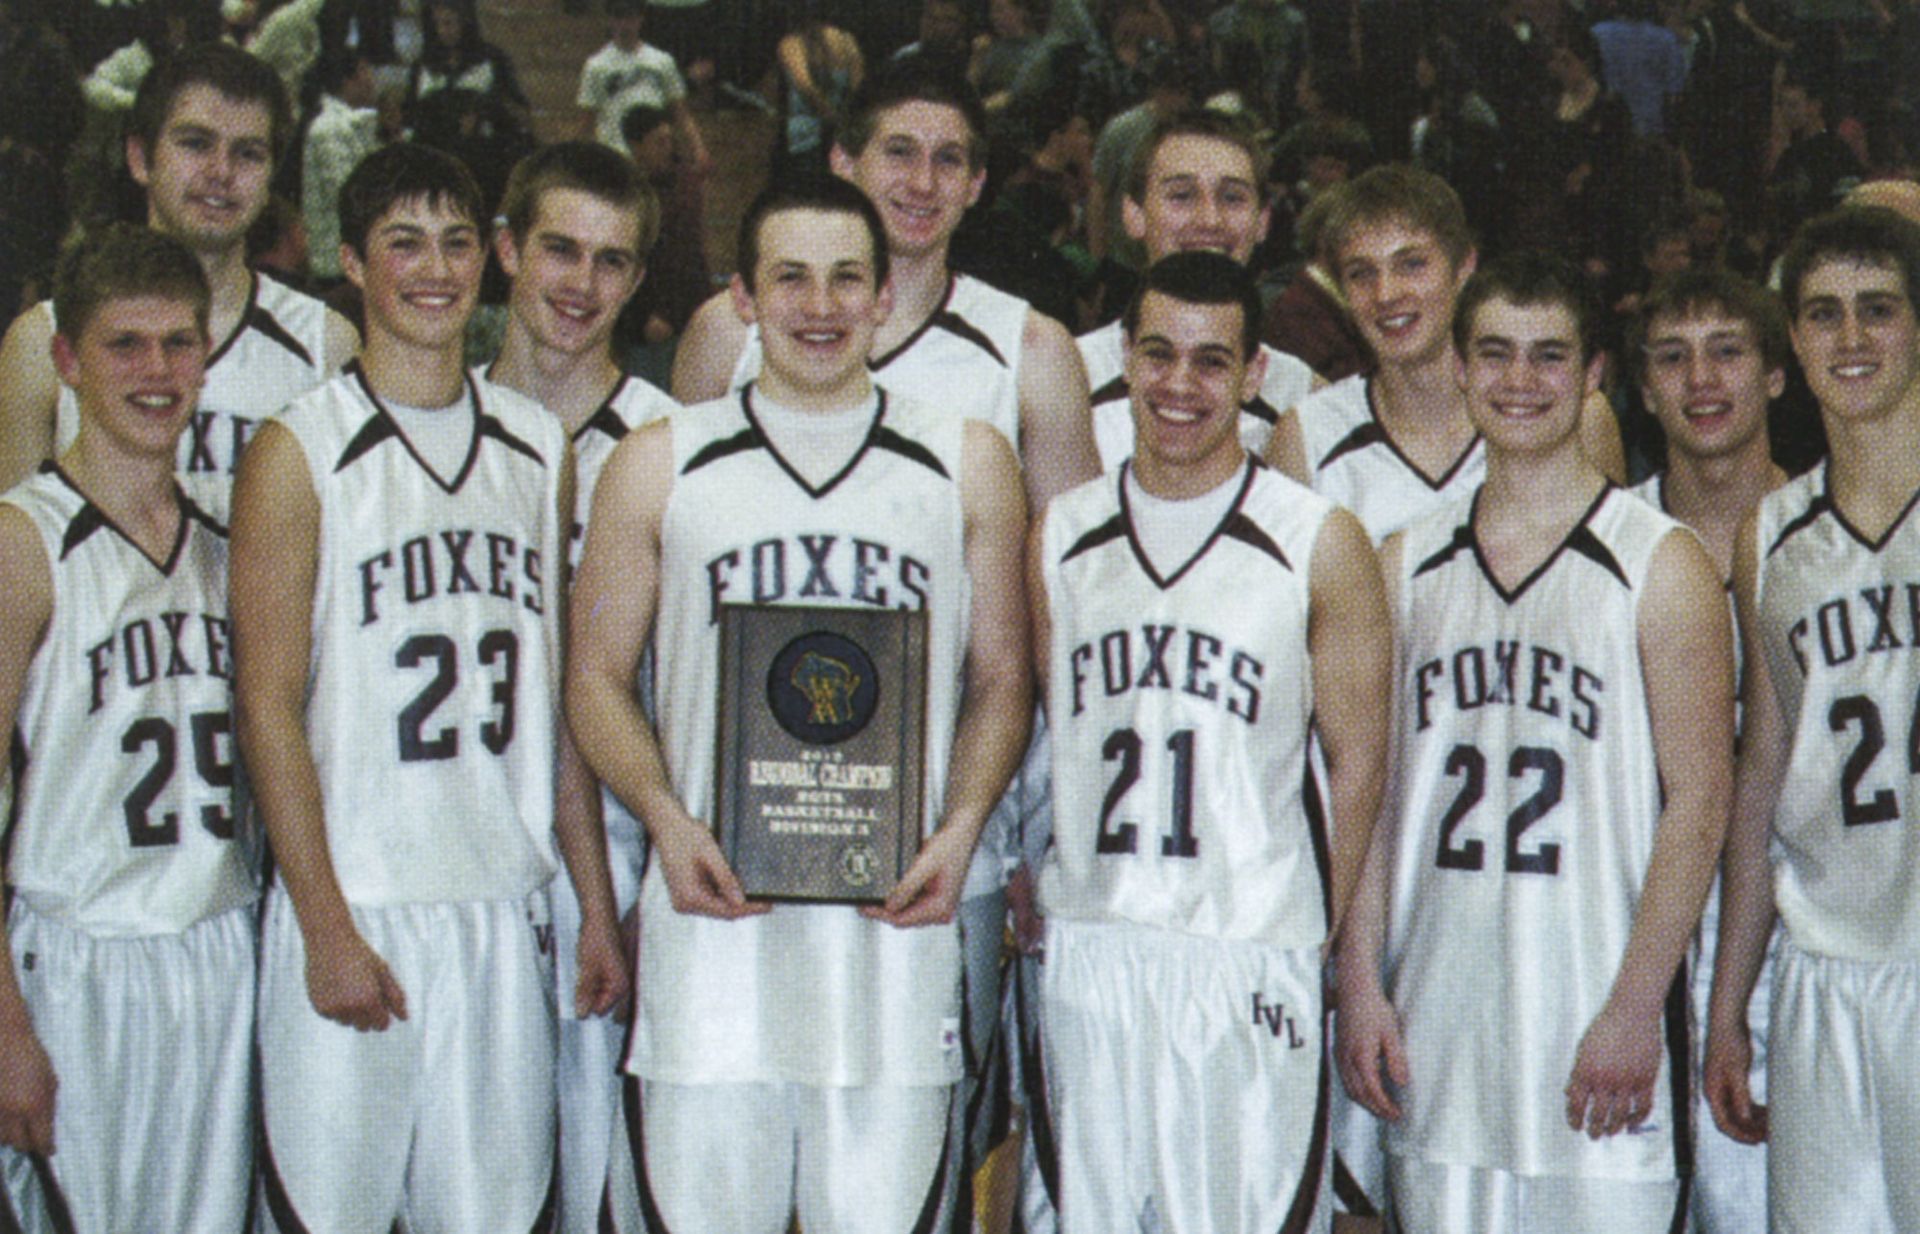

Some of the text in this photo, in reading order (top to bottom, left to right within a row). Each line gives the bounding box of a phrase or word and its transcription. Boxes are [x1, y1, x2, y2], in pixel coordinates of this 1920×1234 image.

[358, 529, 545, 627] FOXES
[706, 534, 931, 626] FOXES
[86, 611, 232, 715] FOXE
[1071, 624, 1264, 725] FOXES
[1788, 583, 1920, 678] FOX
[394, 628, 520, 763] 23
[1416, 640, 1604, 740] FOXES
[761, 804, 879, 821] BASKETBALL
[1095, 727, 1200, 858] 21
[1435, 744, 1565, 876] 22
